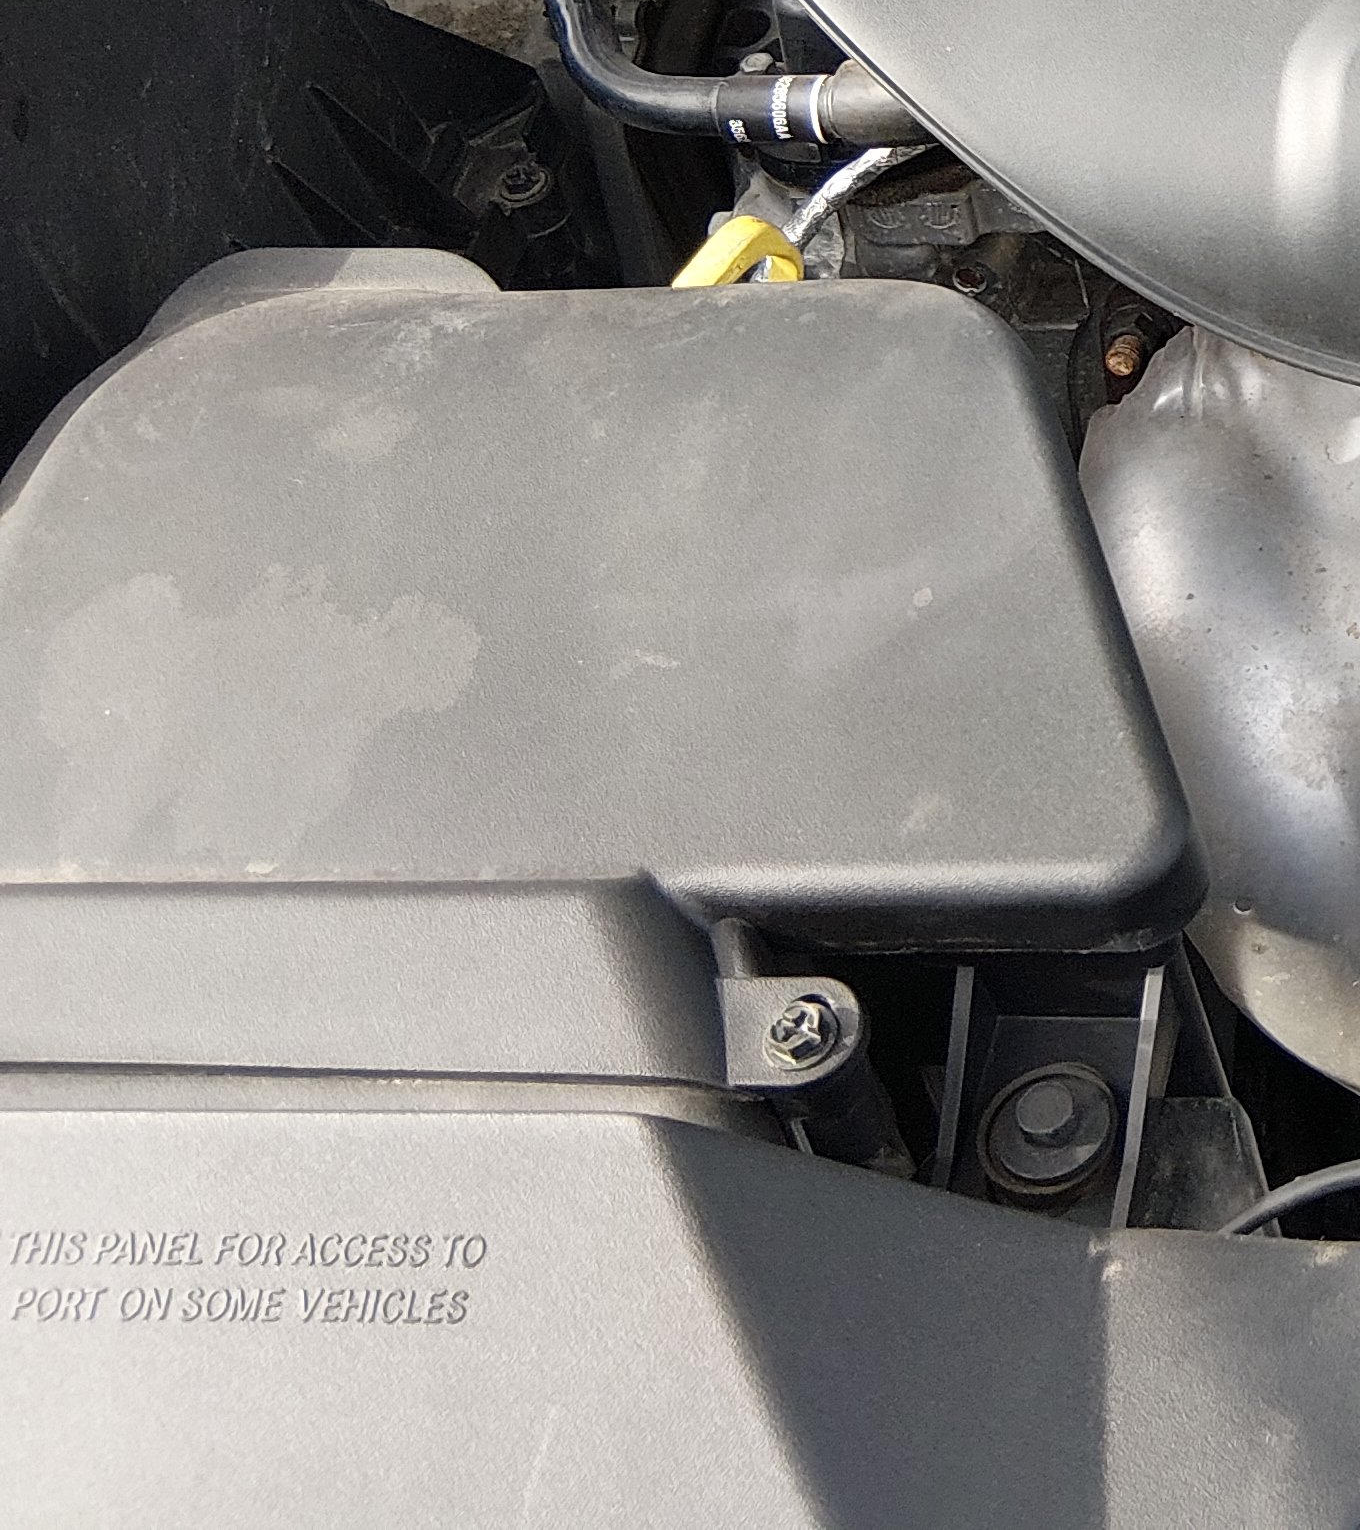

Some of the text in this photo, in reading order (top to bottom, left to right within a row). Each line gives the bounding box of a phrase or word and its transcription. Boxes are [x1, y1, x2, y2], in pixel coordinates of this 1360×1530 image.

[9, 1229, 88, 1267] THIS
[93, 1229, 203, 1267] PANEL
[214, 1230, 287, 1267] FOR
[292, 1231, 432, 1268] ACCESS
[442, 1232, 488, 1268] TO
[11, 1286, 471, 1325] PORT ON SOME VEHICLES
